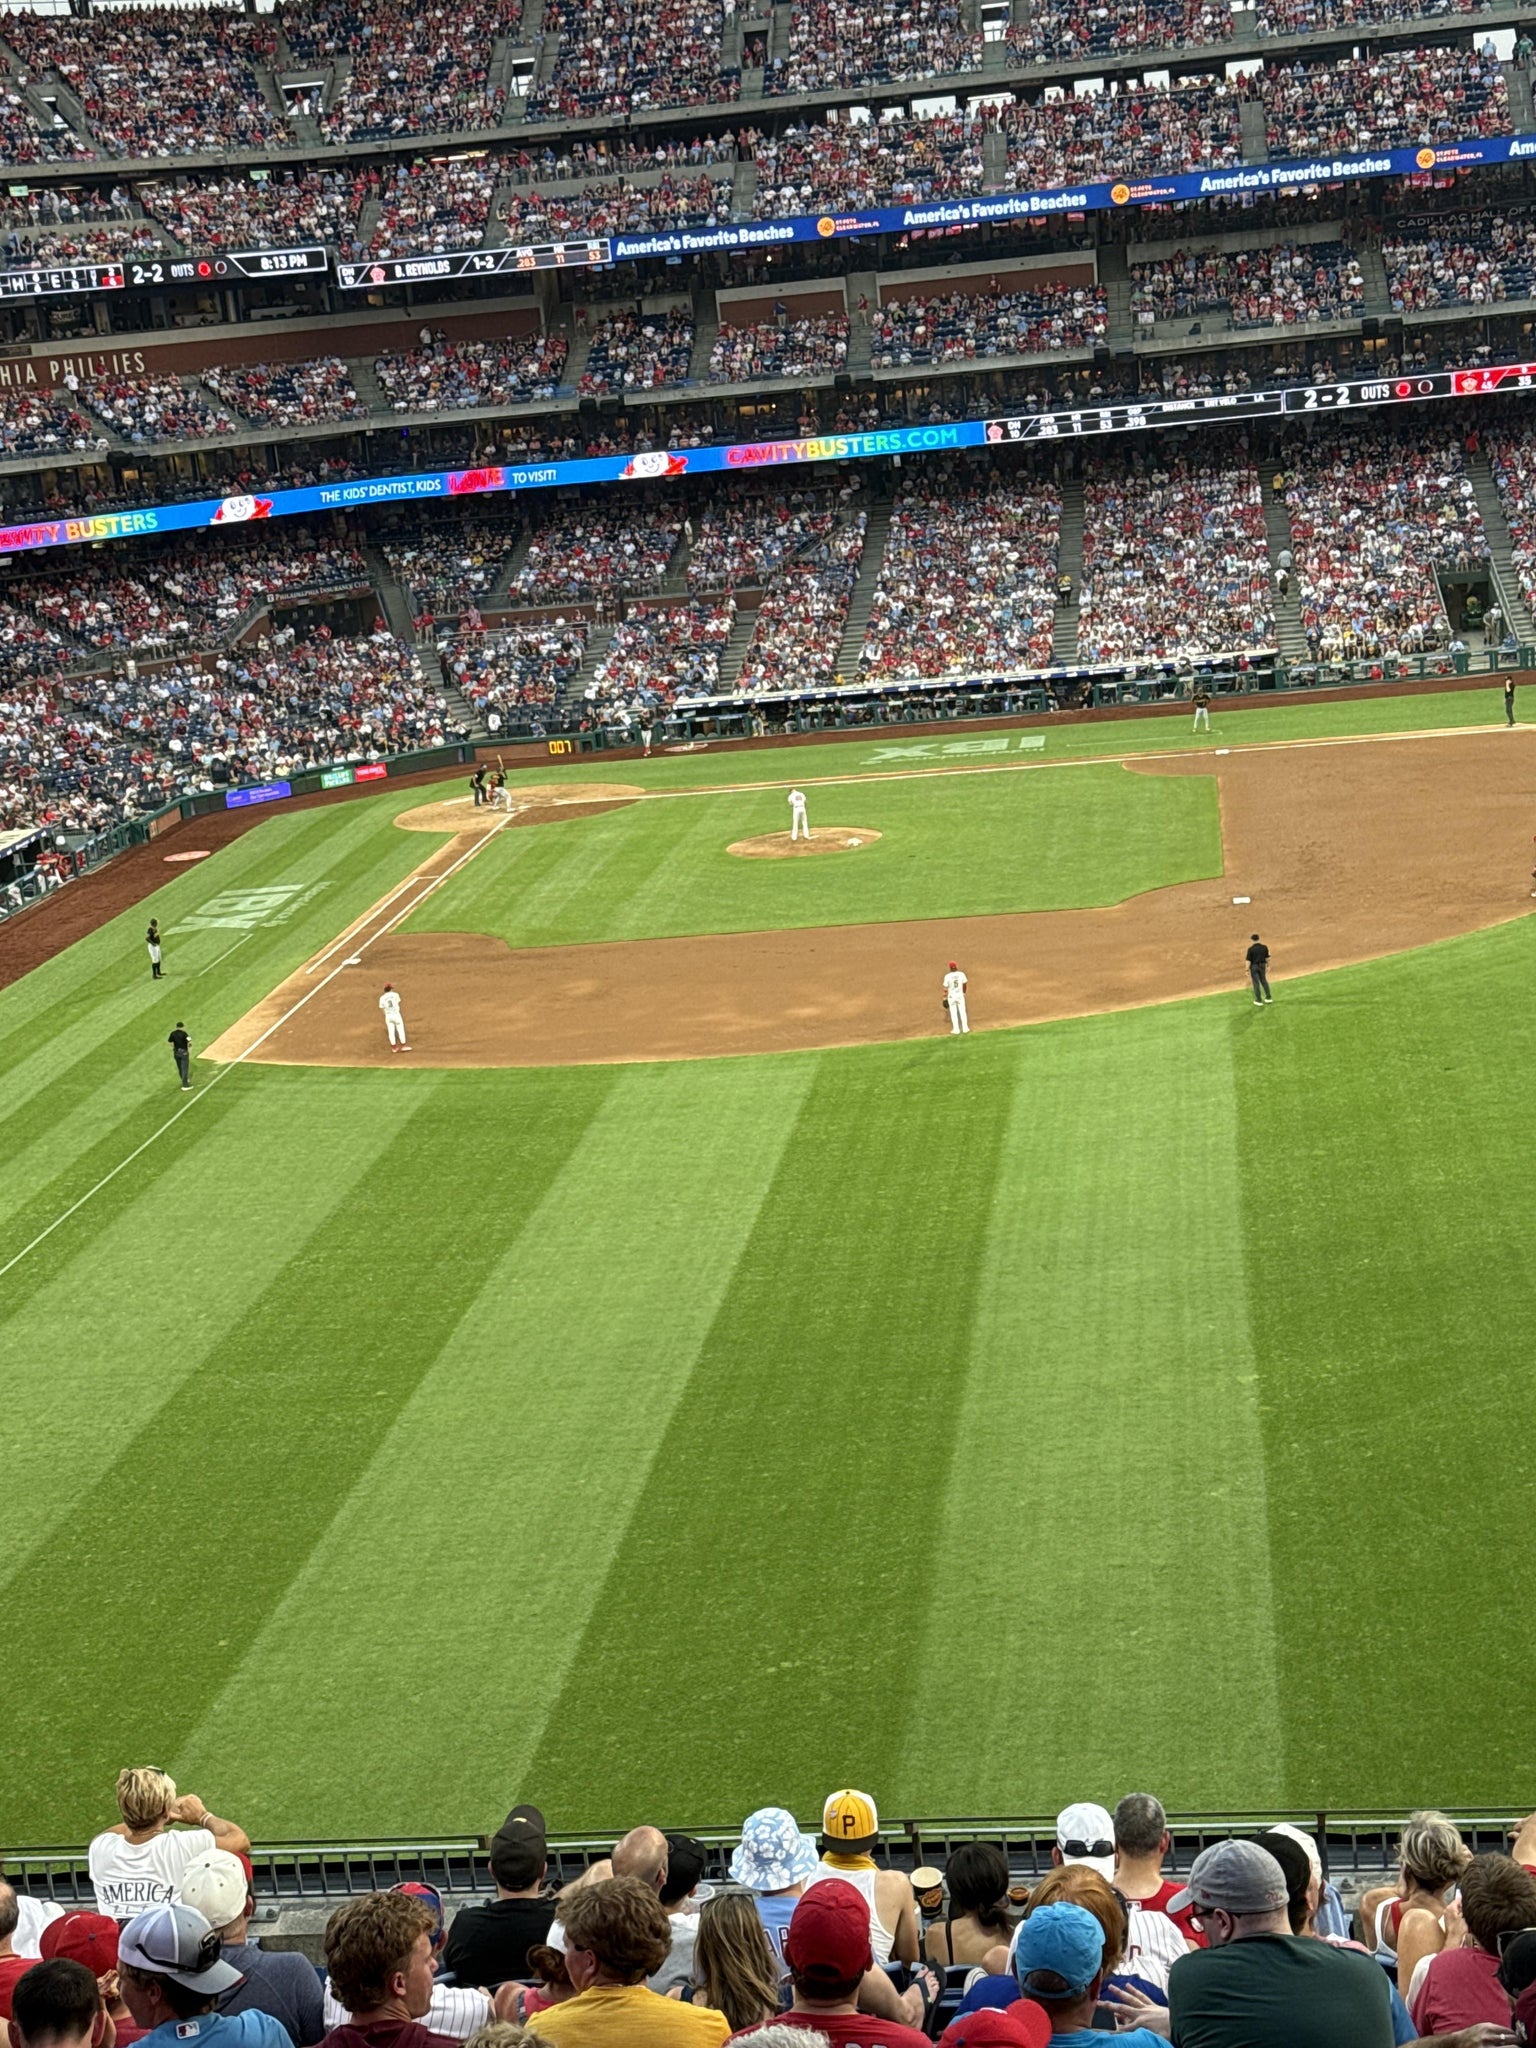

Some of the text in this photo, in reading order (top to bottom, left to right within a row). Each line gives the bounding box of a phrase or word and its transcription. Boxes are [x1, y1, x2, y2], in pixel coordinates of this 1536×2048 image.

[1200, 158, 1391, 192] America's Favorite Beaches
[903, 193, 1087, 225] America's Favorite Beaches
[1509, 206, 1527, 215] OF
[616, 225, 794, 256] America's Favorite Beaches
[260, 253, 307, 270] 8:13 PM
[405, 260, 450, 276] REYNOLDS
[473, 255, 495, 270] 1-2
[50, 274, 61, 288] E
[132, 263, 194, 284] 2-2 OUTS
[12, 277, 24, 291] H
[1361, 384, 1389, 400] OUTS
[1072, 422, 1082, 432] 11
[728, 428, 958, 465] CAVITYBUSTERS.COM
[320, 489, 341, 503] THE
[369, 481, 415, 498] DENTIST,
[416, 479, 441, 492] KIDS
[512, 472, 527, 485] TO
[65, 512, 158, 540] BUSTERS
[549, 740, 571, 754] 007
[842, 1815, 856, 1836] P
[102, 1882, 174, 1904] AMERICA
